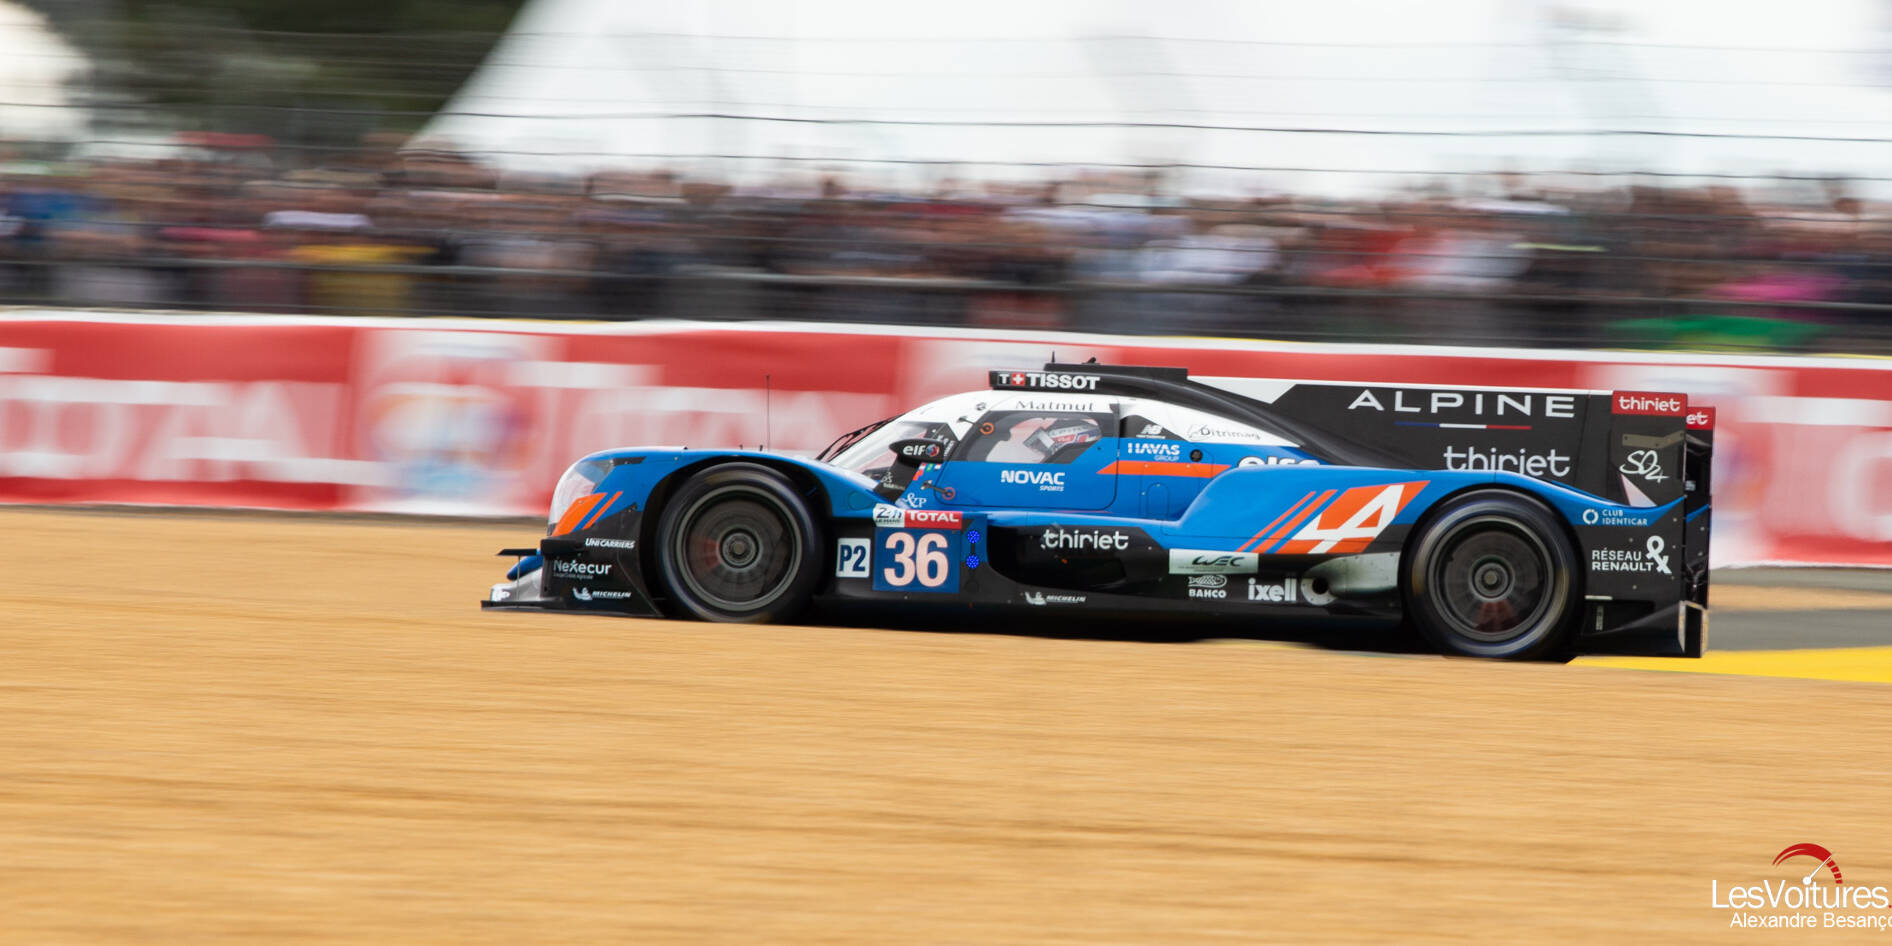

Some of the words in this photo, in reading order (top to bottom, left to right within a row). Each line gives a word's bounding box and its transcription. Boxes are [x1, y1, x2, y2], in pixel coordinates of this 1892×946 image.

[1027, 373, 1100, 390] TISSOT
[1016, 401, 1095, 411] Matmut
[1347, 389, 1575, 418] ALPINE
[1618, 396, 1680, 412] thiriet
[903, 444, 926, 456] elf
[1127, 443, 1180, 455] HAVAS
[1443, 446, 1570, 477] thiriet
[1001, 470, 1065, 485] NOVAC
[906, 510, 959, 522] TOTAL
[1602, 518, 1648, 526] IDENTICAR
[1043, 529, 1129, 550] thiriet
[839, 544, 866, 572] P2
[884, 532, 949, 587] 36
[1192, 555, 1245, 567] WEC
[1592, 547, 1641, 561] RÉSEAU
[553, 560, 613, 575] Nexecur
[1592, 562, 1654, 571] RENAULT
[1188, 589, 1226, 598] BAHCO
[1248, 577, 1297, 602] ixell
[1046, 595, 1086, 603] MICHELIN
